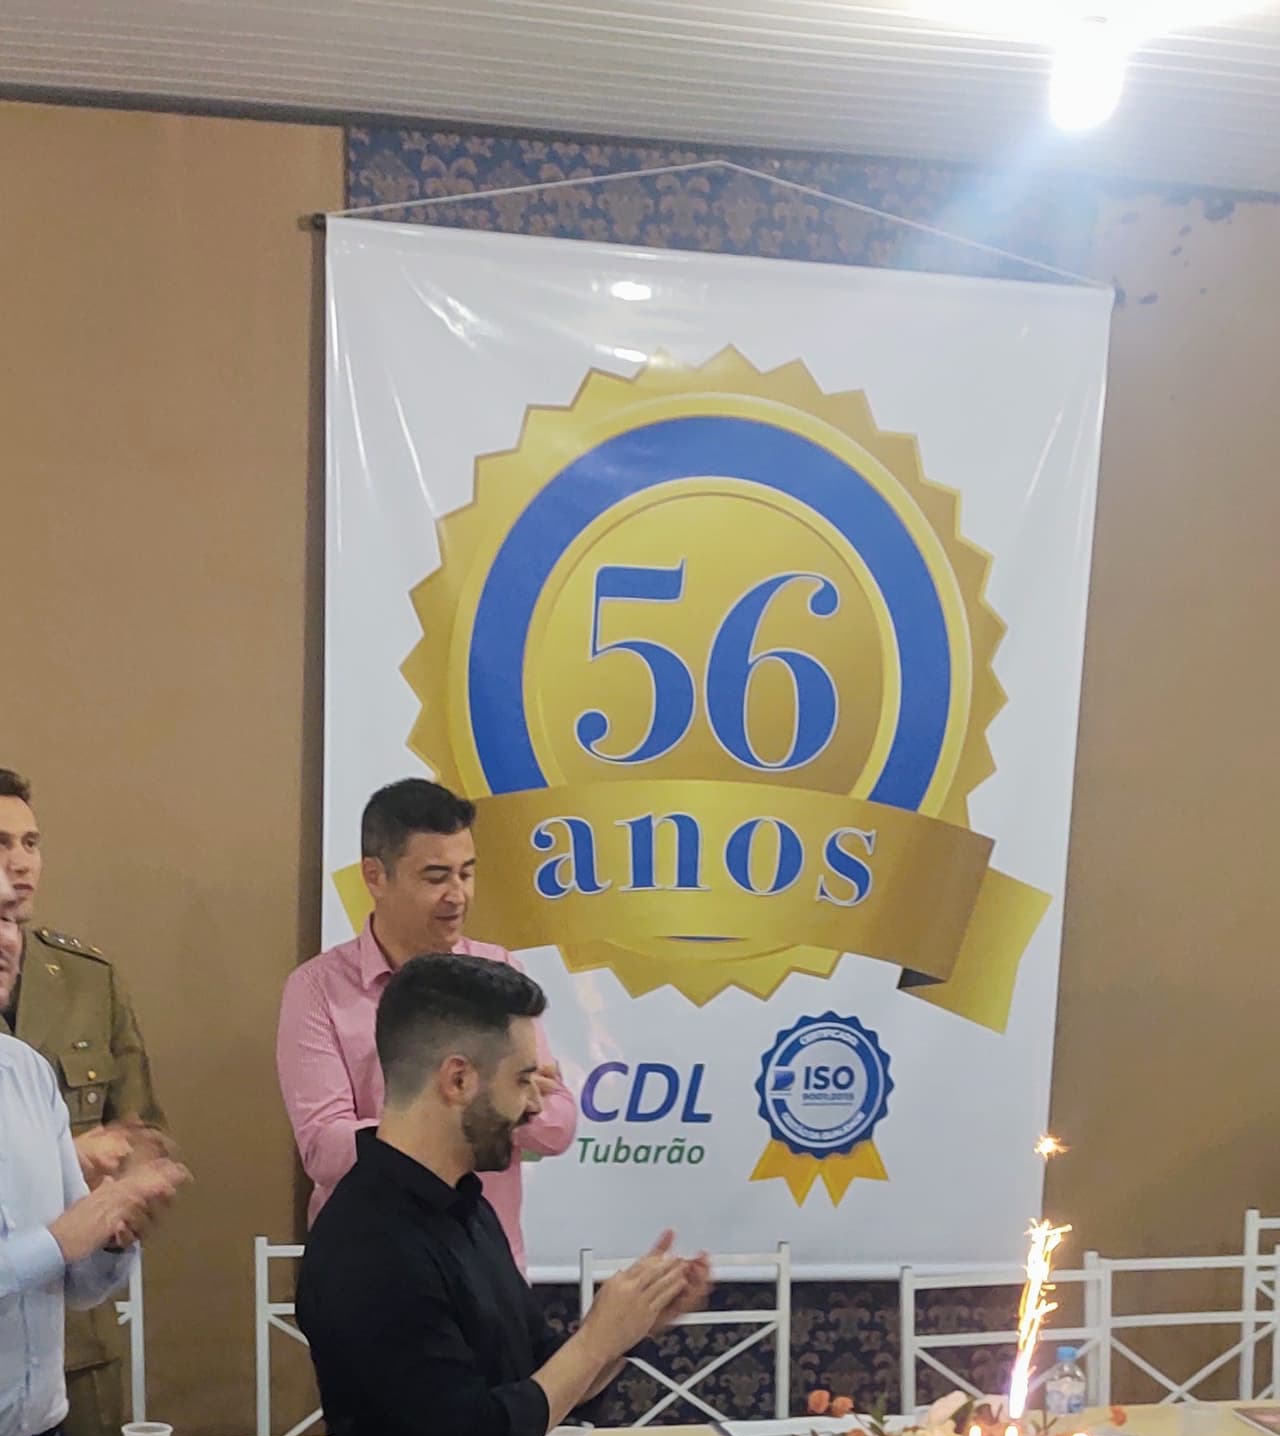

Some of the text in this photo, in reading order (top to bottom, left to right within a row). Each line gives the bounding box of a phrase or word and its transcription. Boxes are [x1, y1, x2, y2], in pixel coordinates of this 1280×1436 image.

[574, 558, 841, 774] 56
[529, 810, 880, 908] anos
[579, 1061, 714, 1124] CDL
[803, 1065, 855, 1090] ISO
[576, 1136, 705, 1165] Tubarão
